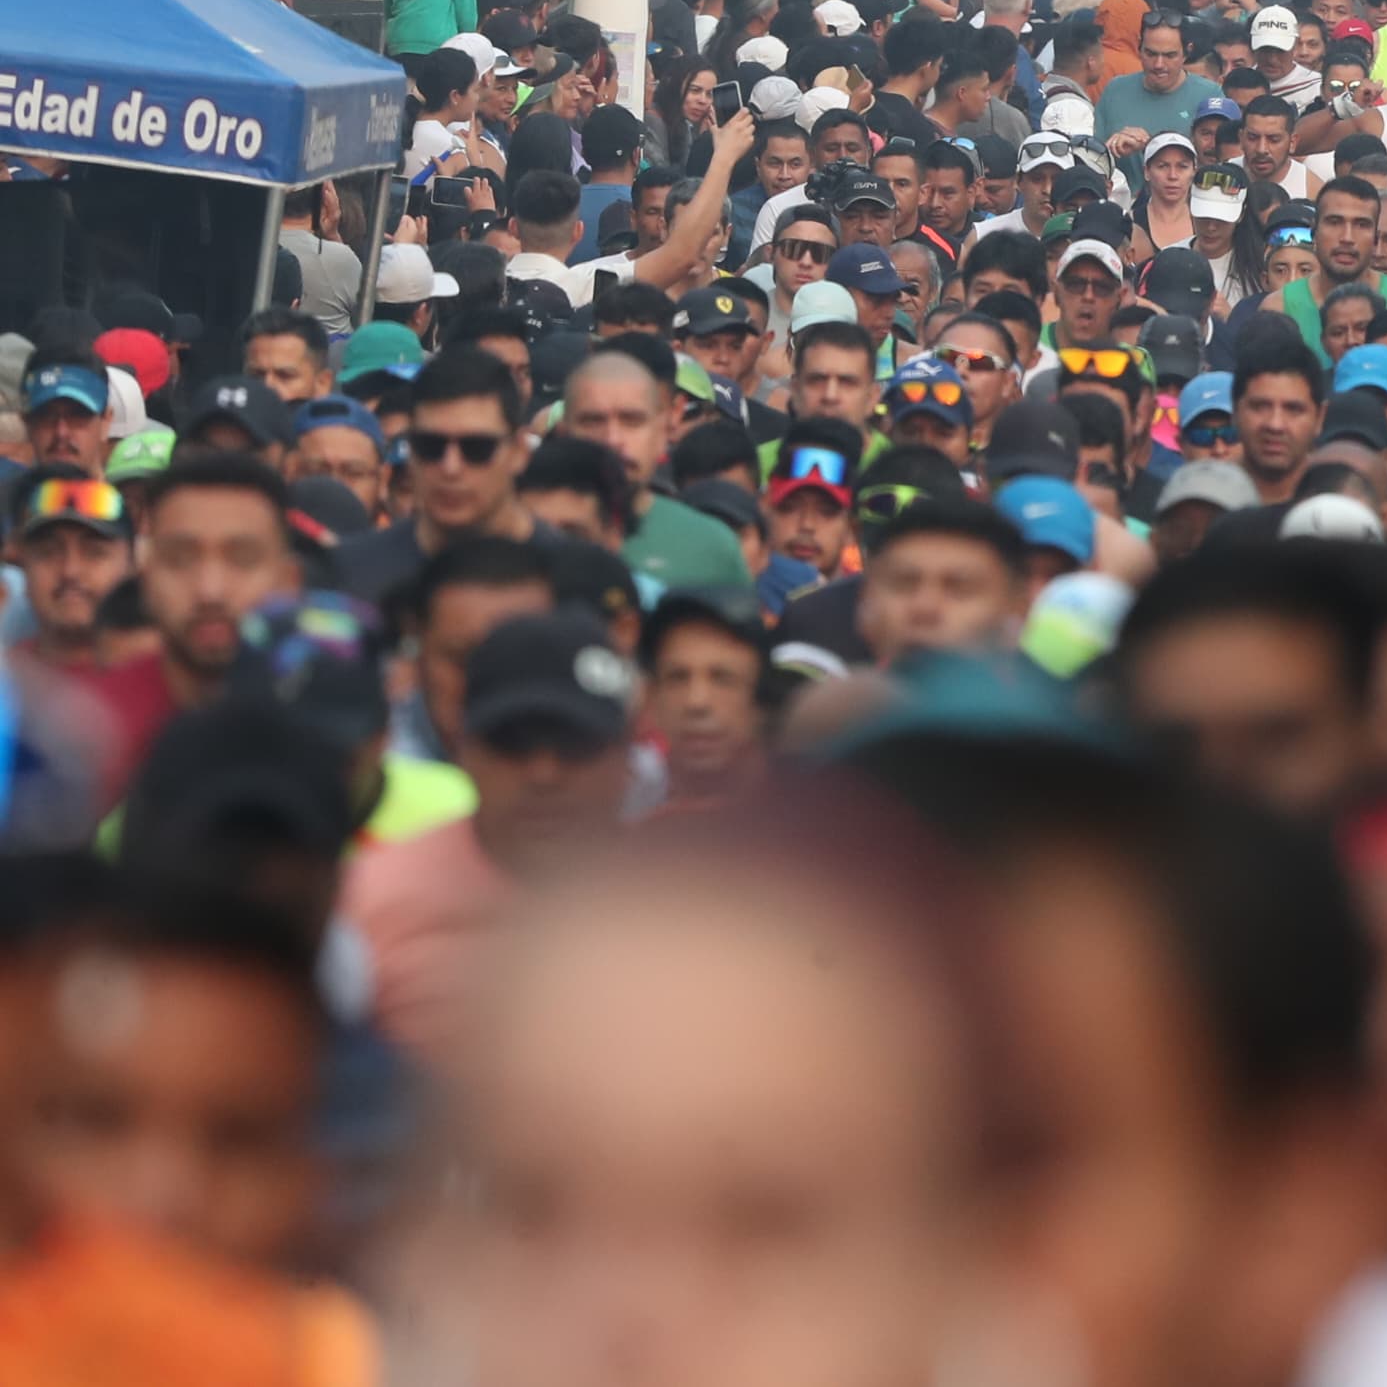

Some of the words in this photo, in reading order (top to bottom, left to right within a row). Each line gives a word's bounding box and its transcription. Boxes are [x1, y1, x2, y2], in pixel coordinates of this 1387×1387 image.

[1258, 21, 1288, 32] PING
[0, 75, 99, 138] Edad
[112, 91, 168, 146] de
[183, 98, 264, 160] Oro
